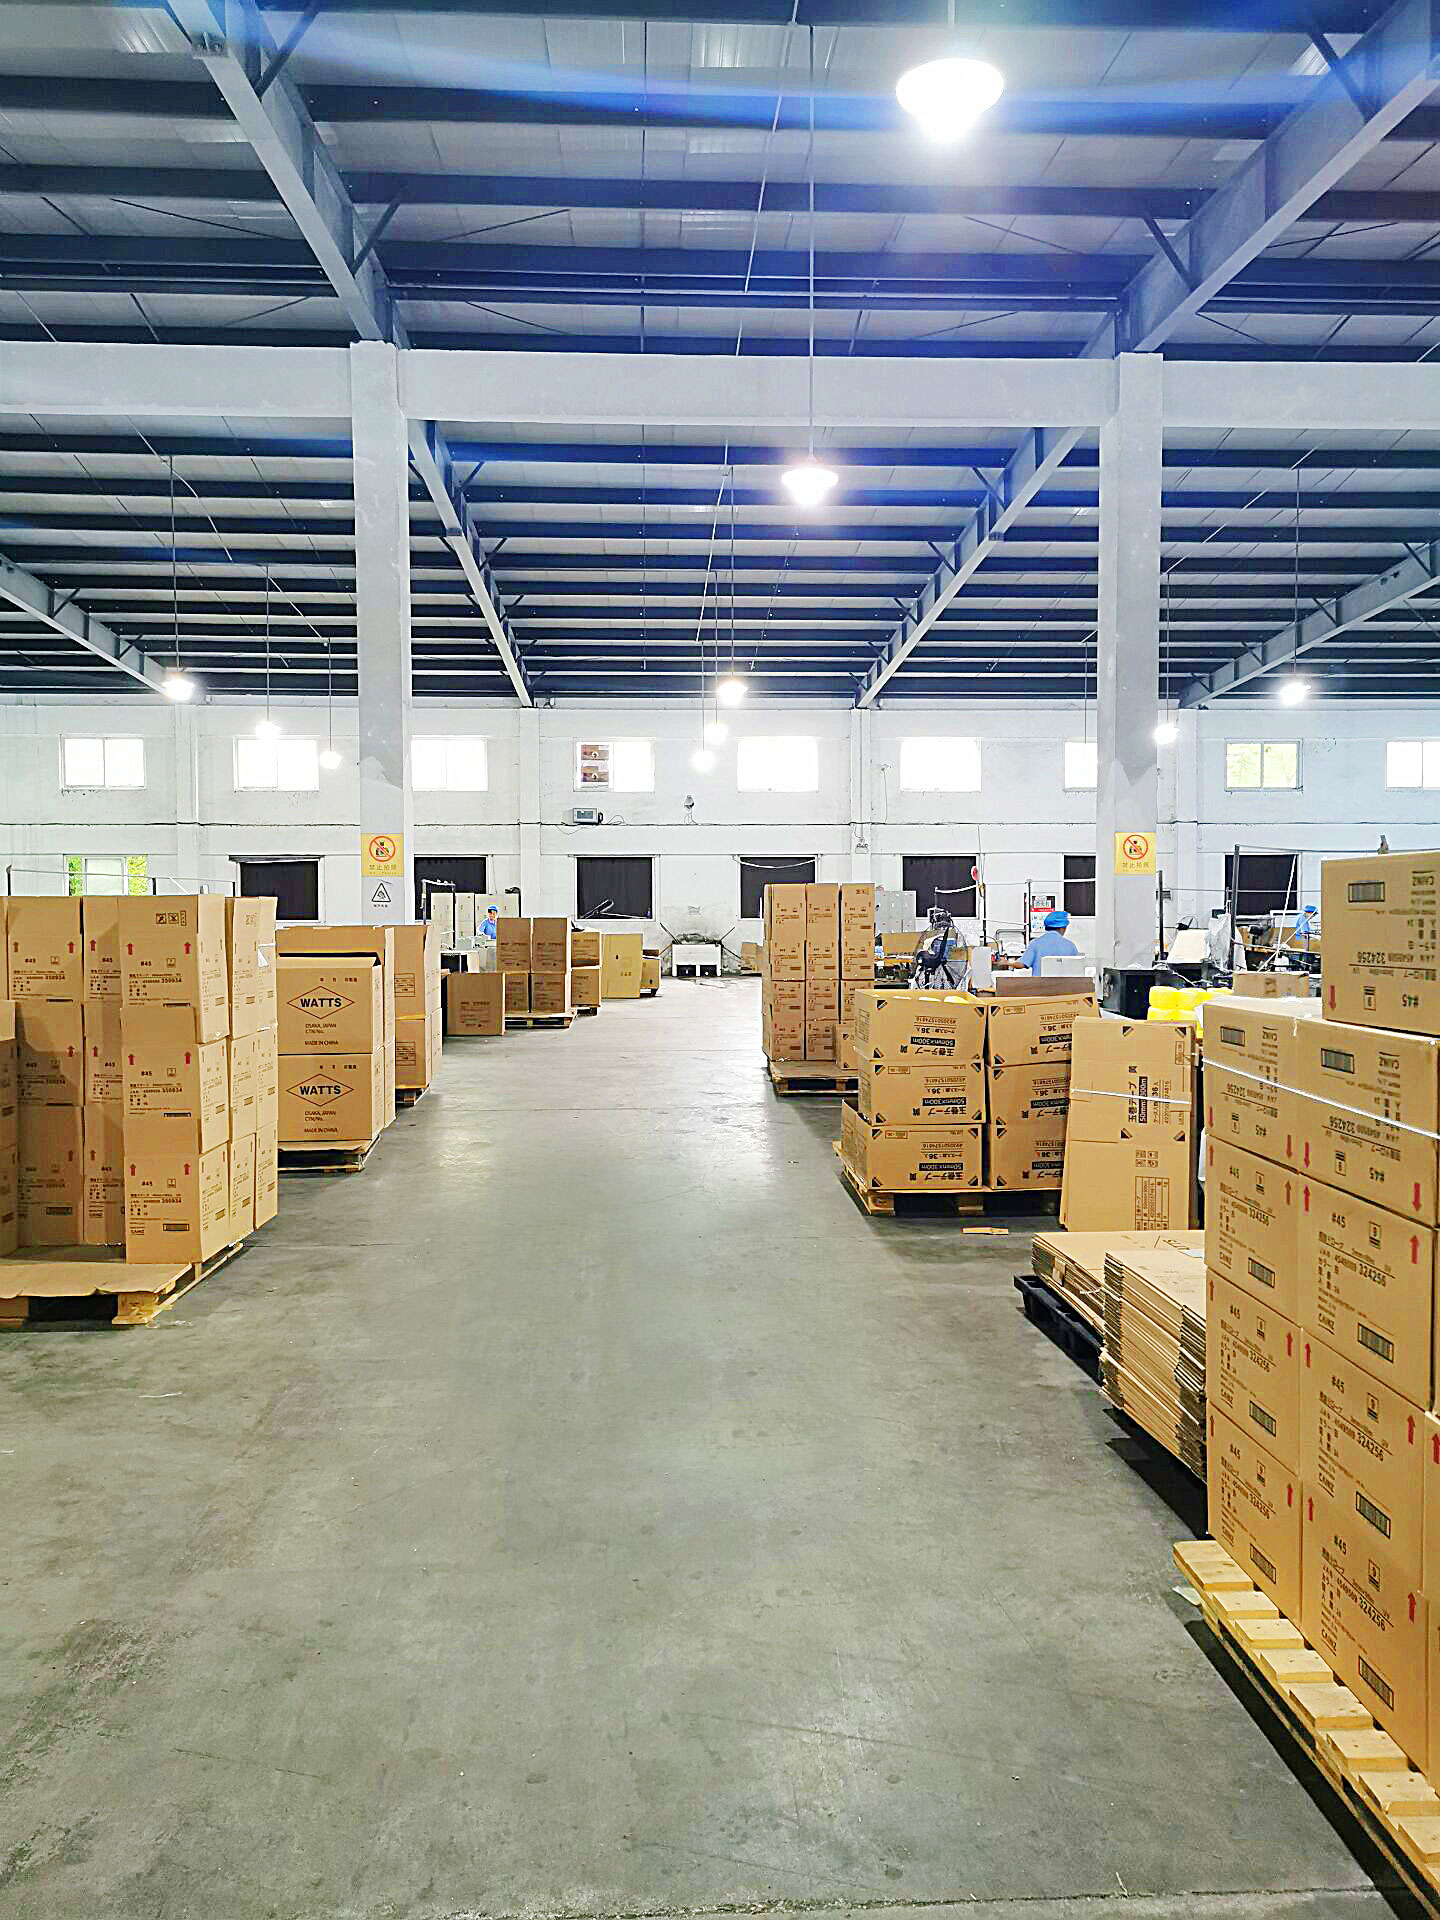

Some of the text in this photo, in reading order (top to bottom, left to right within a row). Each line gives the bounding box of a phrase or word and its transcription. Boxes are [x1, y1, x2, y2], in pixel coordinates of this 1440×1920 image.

[1357, 951, 1386, 965] 324256
[300, 998, 342, 1008] WATTS
[300, 1085, 342, 1095] WATTS
[1139, 1078, 1147, 1122] 50mm300m
[1359, 1263, 1387, 1288] 324256
[1357, 1432, 1384, 1462] 324256
[1358, 1597, 1386, 1632] 324256
